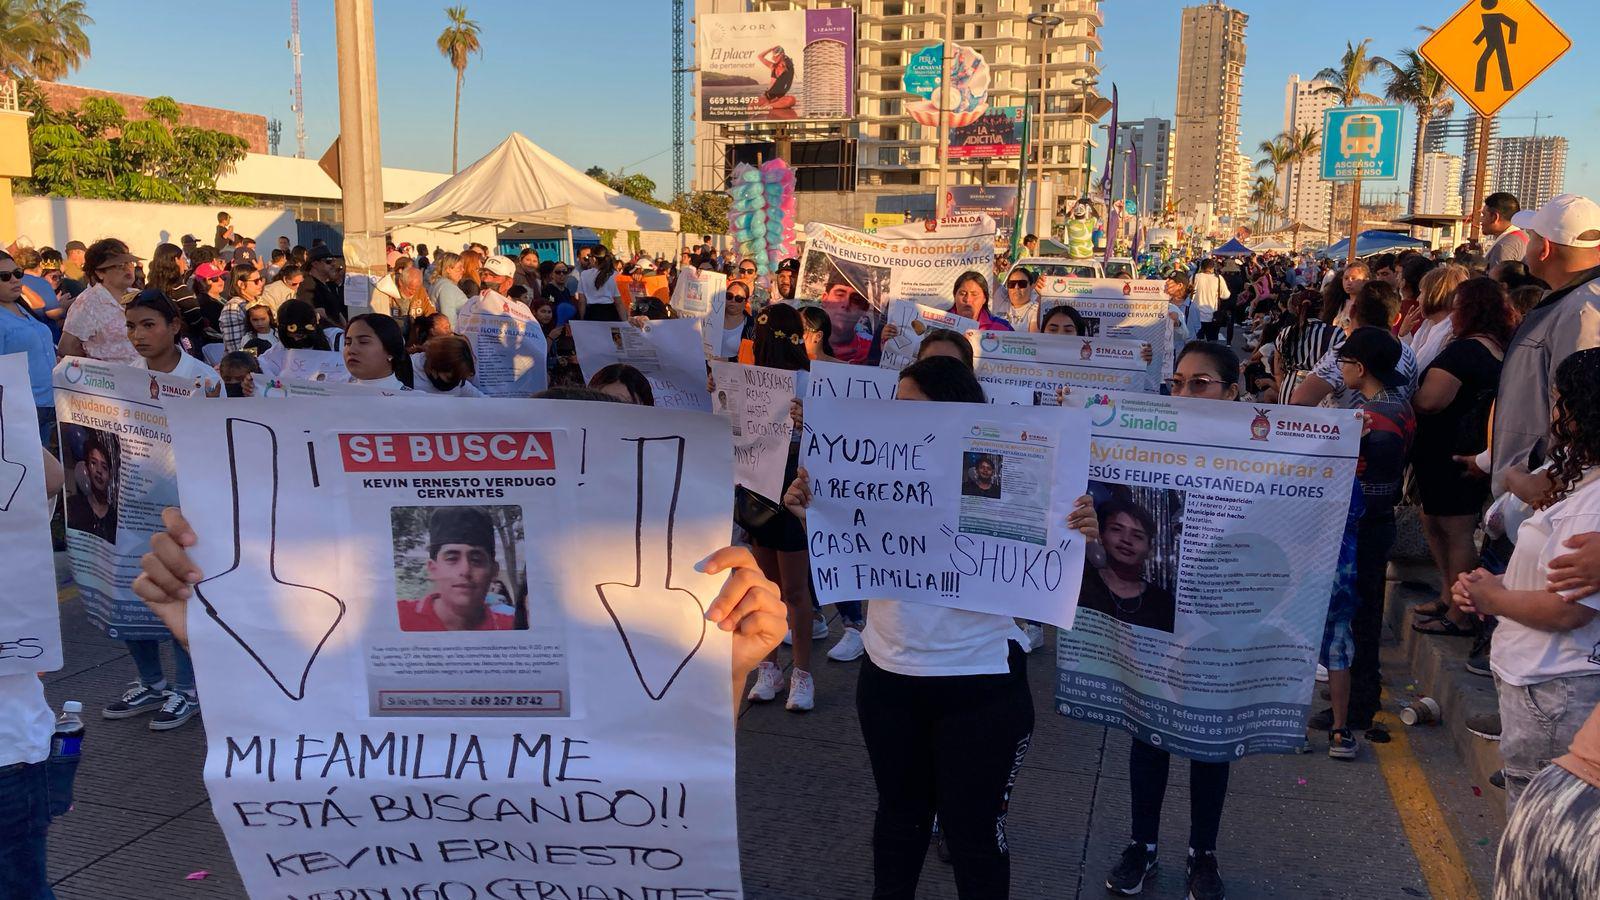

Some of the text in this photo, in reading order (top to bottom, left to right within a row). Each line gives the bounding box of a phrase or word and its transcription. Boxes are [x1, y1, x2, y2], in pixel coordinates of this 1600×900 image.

[730, 24, 776, 32] AZORA
[710, 48, 755, 62] El placer
[978, 126, 988, 134] LA
[963, 134, 1004, 145] ADICTIVA
[812, 239, 990, 268] KEVIN ERNESTO VERDUGO CERVANTES
[891, 244, 898, 253] a
[902, 243, 967, 254] encontrar
[1002, 344, 1036, 356] Sinaloa
[1096, 347, 1134, 356] SINALOA
[980, 362, 1132, 384] Ayúdanos a encontrar a
[84, 375, 115, 390] Sinaloa
[162, 384, 190, 396] SINALOA
[70, 396, 119, 417] Ayúdanos
[124, 409, 130, 417] a
[71, 412, 90, 425] JESÚS
[90, 416, 112, 432] FELIPE
[114, 422, 160, 440] CASTAÑEDA
[1120, 414, 1178, 432] Sinaloa
[1276, 420, 1340, 434] SINALOA
[348, 434, 548, 464] SE BUSCA
[1090, 440, 1334, 478] Ayúdanos a encontrar a
[362, 476, 556, 488] KEVIN ERNESTO VERDUGO
[1088, 464, 1324, 498] ESÚS FELIPE CASTAÑEDA FLORES
[417, 488, 504, 499] CERVANTES
[814, 478, 933, 506] A REGRESAR
[1200, 502, 1222, 510] Febrero
[1214, 496, 1254, 504] Desaparición:
[854, 508, 866, 526] A
[1186, 508, 1216, 517] Municipio
[1185, 524, 1201, 532] Sexo:
[811, 530, 926, 558] CASA CON
[470, 696, 490, 706] 669
[492, 696, 514, 706] 267
[516, 696, 544, 706] 8742
[1060, 672, 1070, 682] Si
[1075, 676, 1108, 690] tienes
[1112, 683, 1168, 713] información
[1172, 708, 1222, 724] referente
[1236, 710, 1254, 720] esta
[1258, 707, 1304, 718] persona,
[1060, 684, 1088, 698] llama
[1157, 714, 1170, 725] Tu
[1172, 720, 1206, 736] ayuda
[1225, 724, 1244, 735] muy
[1246, 720, 1302, 730] importante.
[1087, 711, 1104, 720] 669
[1105, 714, 1120, 724] 327
[225, 732, 602, 786] MI FAMILIA ME
[233, 783, 687, 830] ESTÁ BUSCANDO!!
[266, 839, 685, 878] KEVIN ERNESTO
